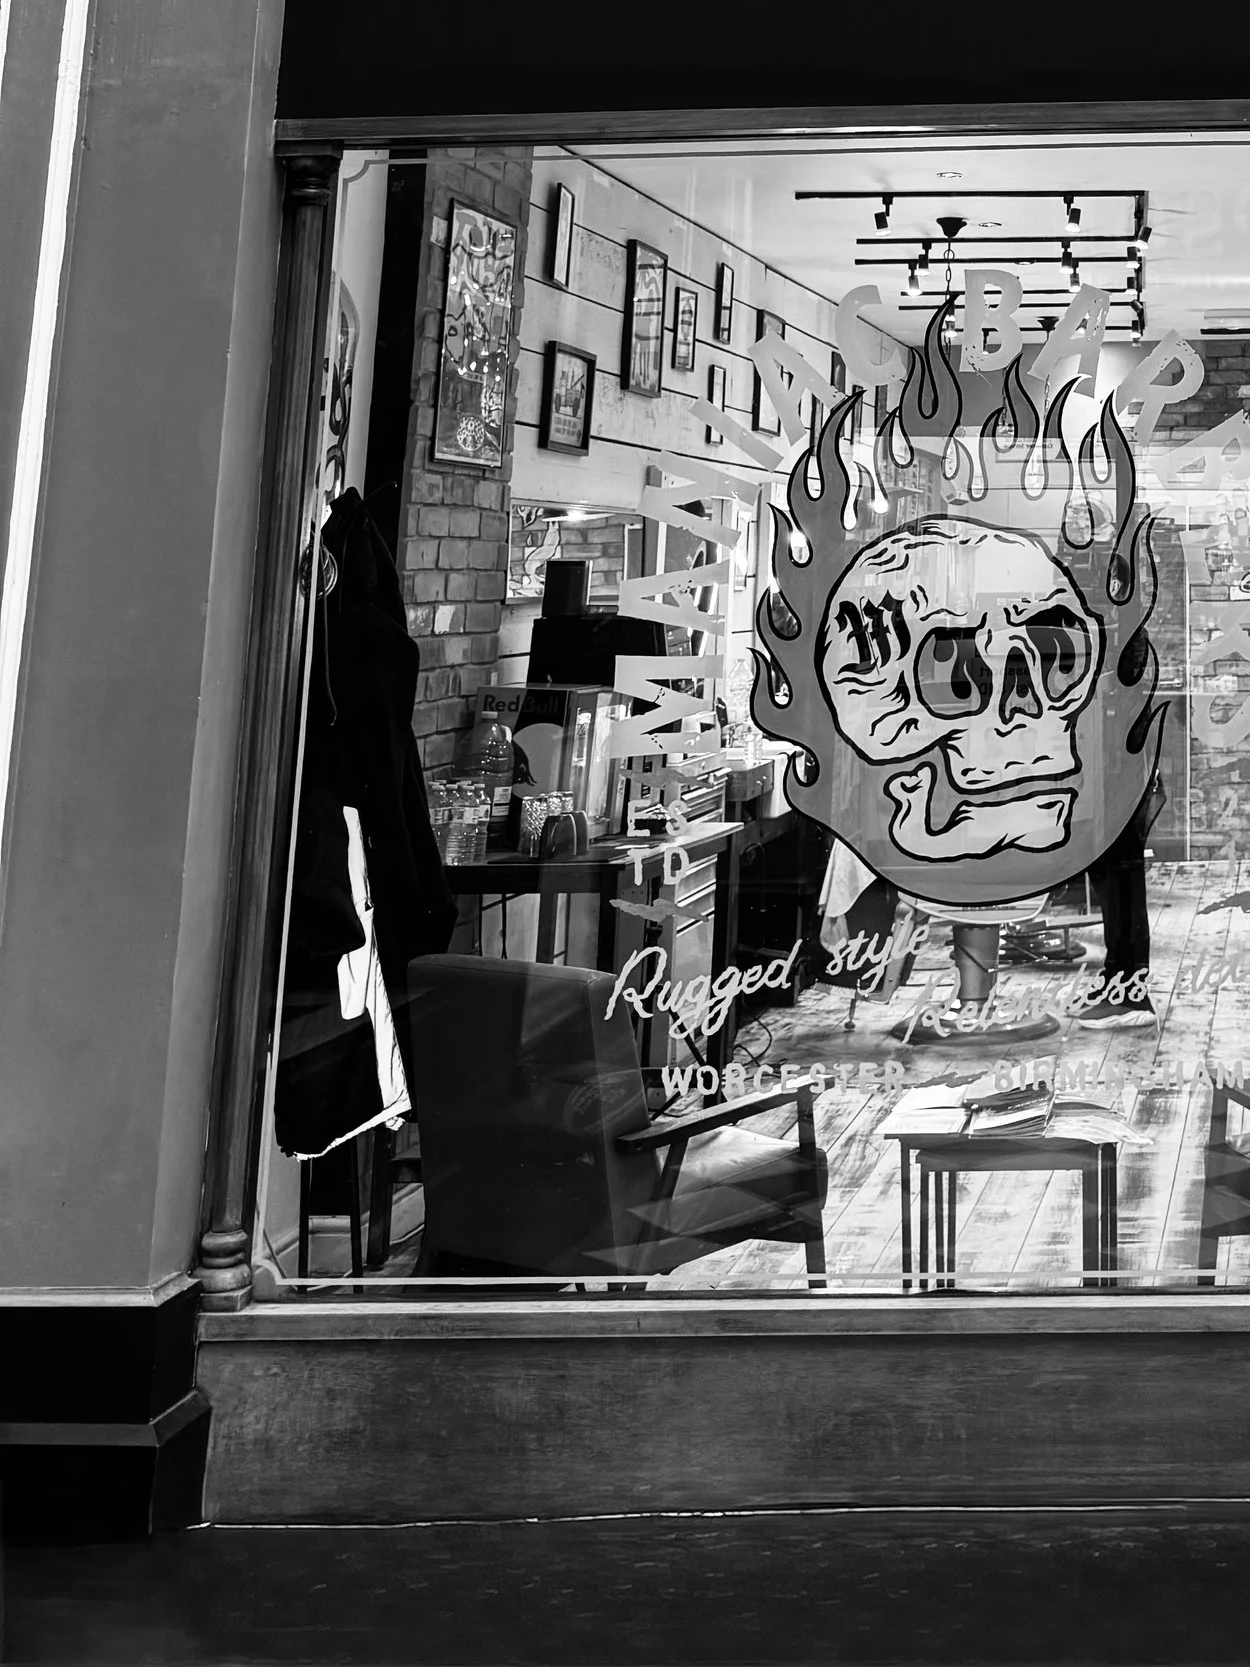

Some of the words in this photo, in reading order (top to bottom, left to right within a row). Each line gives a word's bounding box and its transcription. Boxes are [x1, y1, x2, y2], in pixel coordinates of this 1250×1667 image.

[607, 284, 909, 760] MANIAC
[483, 694, 521, 713] Red
[523, 695, 560, 714] Bull
[626, 799, 689, 837] ES
[626, 846, 690, 886] TD
[604, 938, 803, 1040] Rugged
[825, 910, 931, 995] style
[902, 962, 1155, 1044] Relentless
[660, 1060, 905, 1099] WORCESTER
[993, 1059, 1245, 1092] BIRMINGHAM
